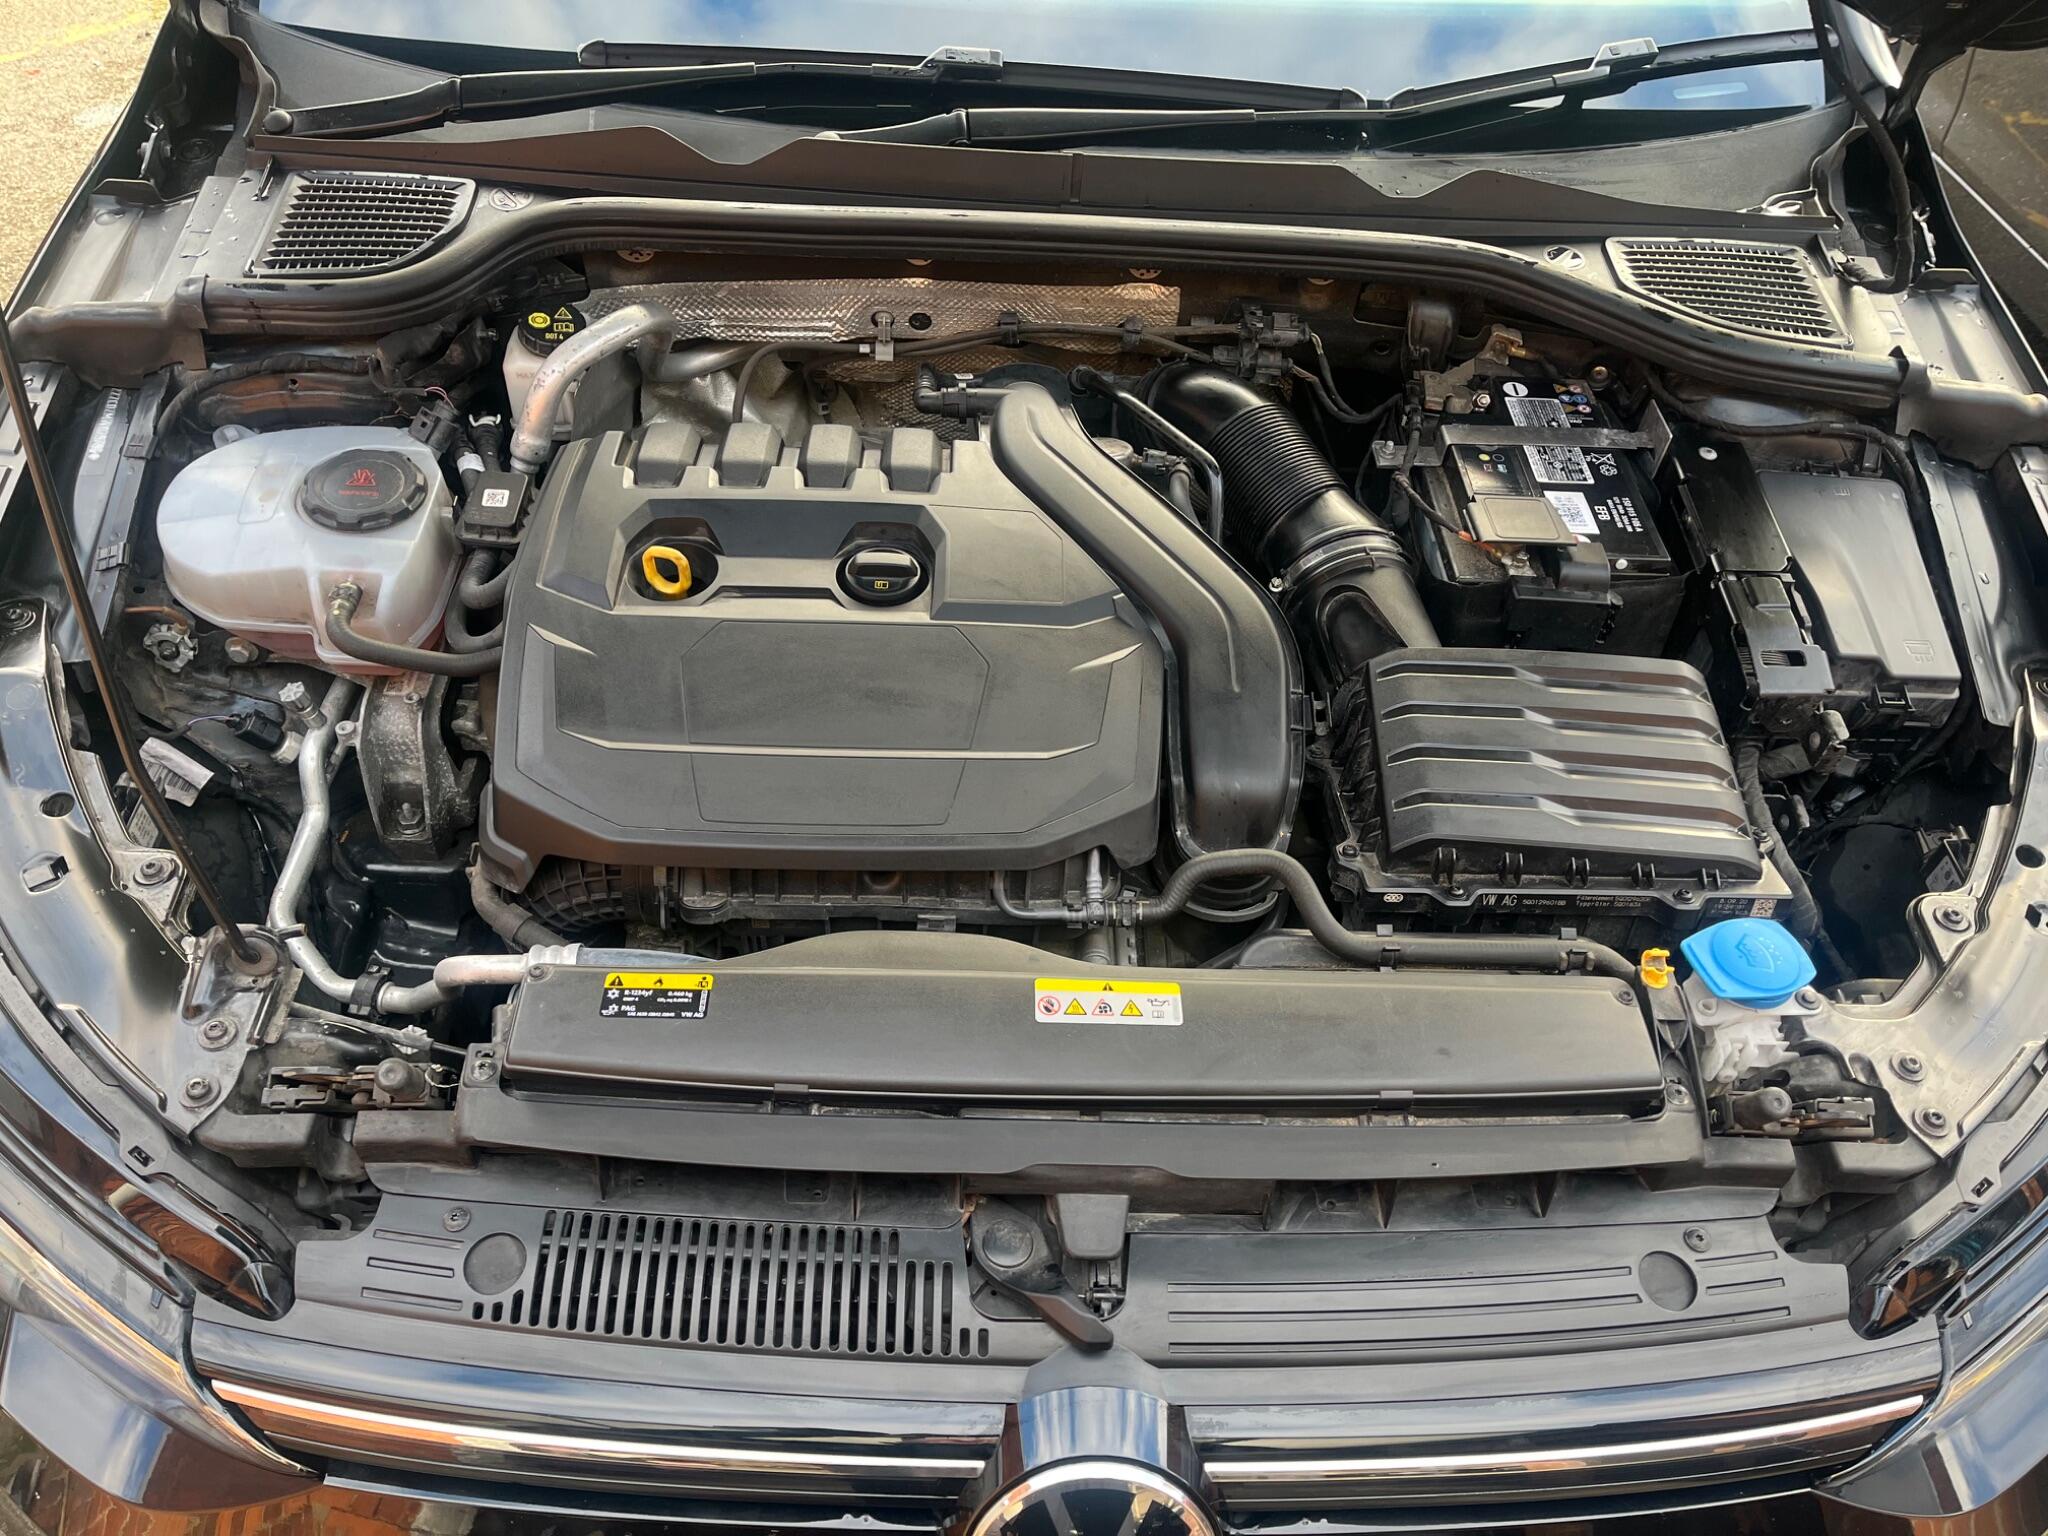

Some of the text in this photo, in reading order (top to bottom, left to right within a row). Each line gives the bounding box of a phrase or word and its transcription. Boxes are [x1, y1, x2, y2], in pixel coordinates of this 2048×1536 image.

[1594, 506, 1611, 520] EFB
[1482, 894, 1498, 906] VW
[1501, 894, 1518, 906] AG
